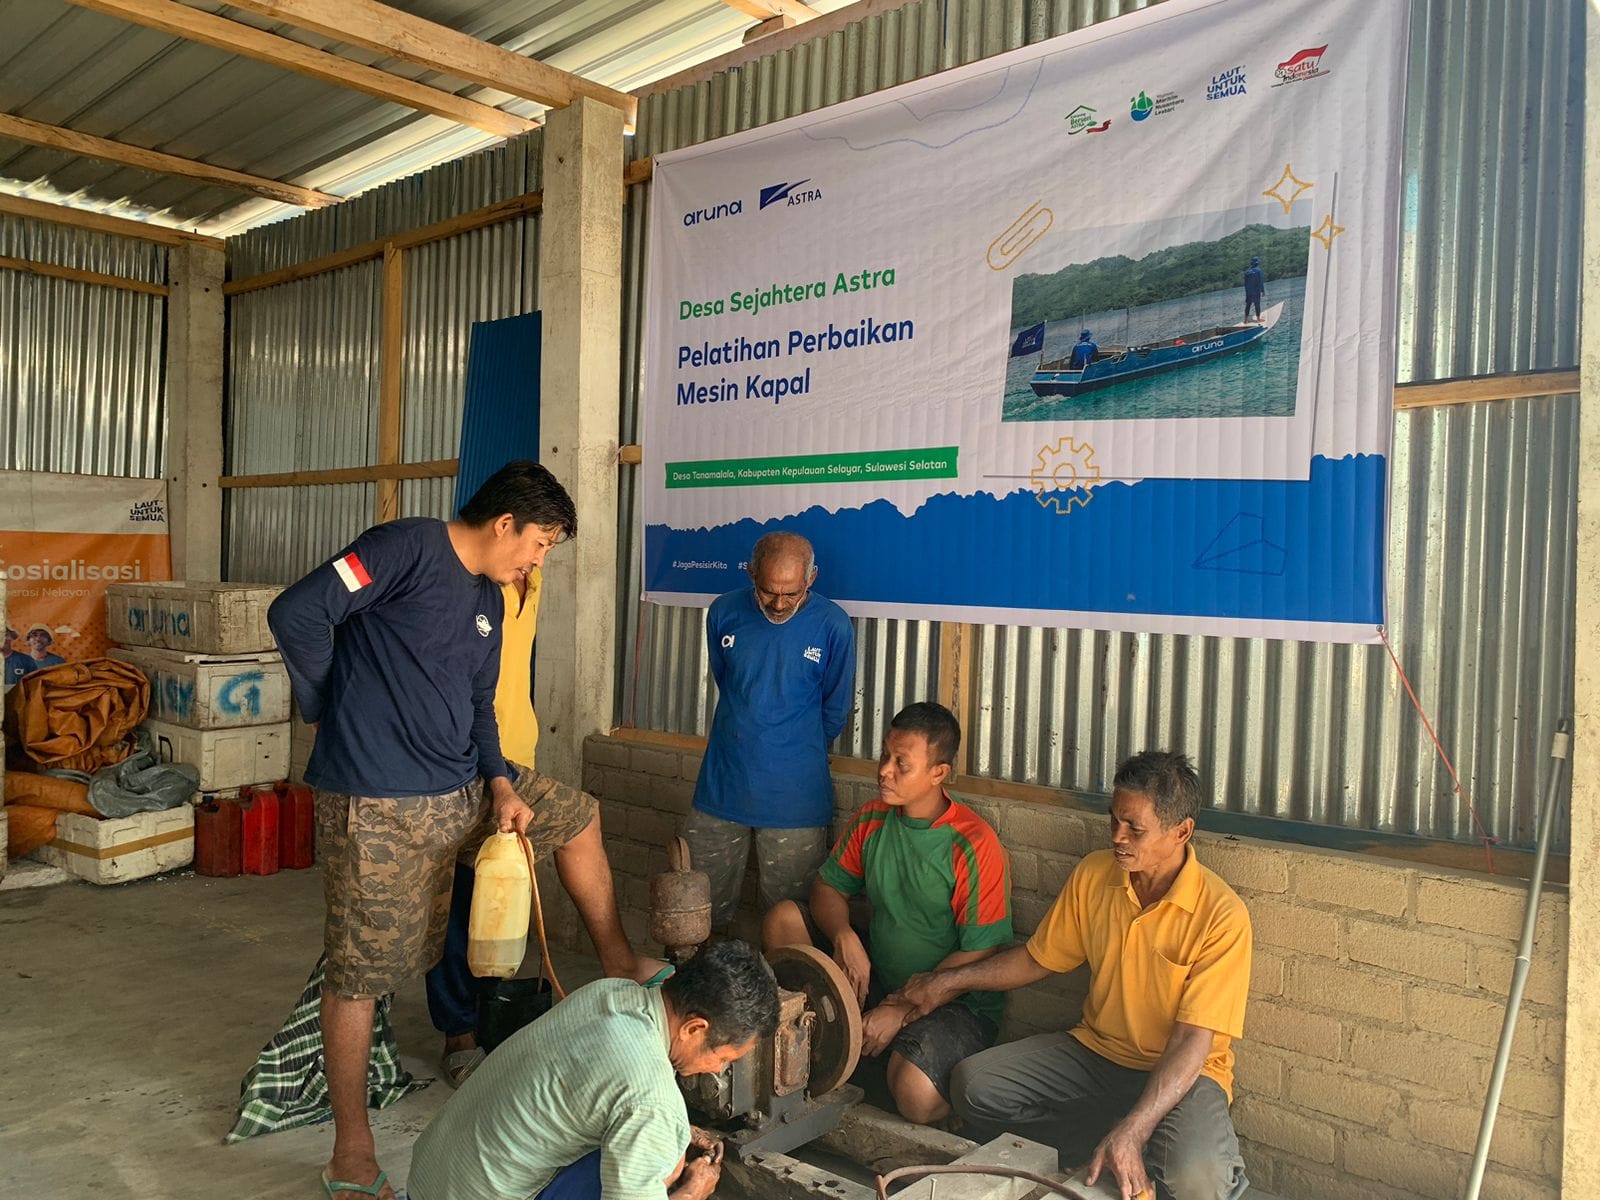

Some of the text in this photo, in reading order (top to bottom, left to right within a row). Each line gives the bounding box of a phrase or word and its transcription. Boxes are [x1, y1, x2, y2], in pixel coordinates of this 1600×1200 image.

[1207, 74, 1246, 93] UNTUK
[1212, 65, 1241, 85] LAUT
[1206, 84, 1247, 101] SEMUA
[787, 189, 822, 207] ASTRA
[683, 200, 743, 226] aruna
[679, 268, 896, 320] Desa Sejahtera Astra
[678, 317, 914, 369] Pelatihan Perbaikan
[1191, 339, 1224, 352] aruna
[677, 367, 811, 406] Mesin Kapal
[673, 472, 691, 481] Desa
[738, 468, 780, 479] Kabupaten
[782, 465, 825, 478] Kepulauan
[827, 464, 863, 476] Selayar,
[865, 460, 907, 472] Sulawesi
[909, 459, 947, 470] Selatan
[130, 506, 164, 515] UNTUK
[134, 499, 159, 509] LAUT
[129, 514, 165, 522] SEMUA
